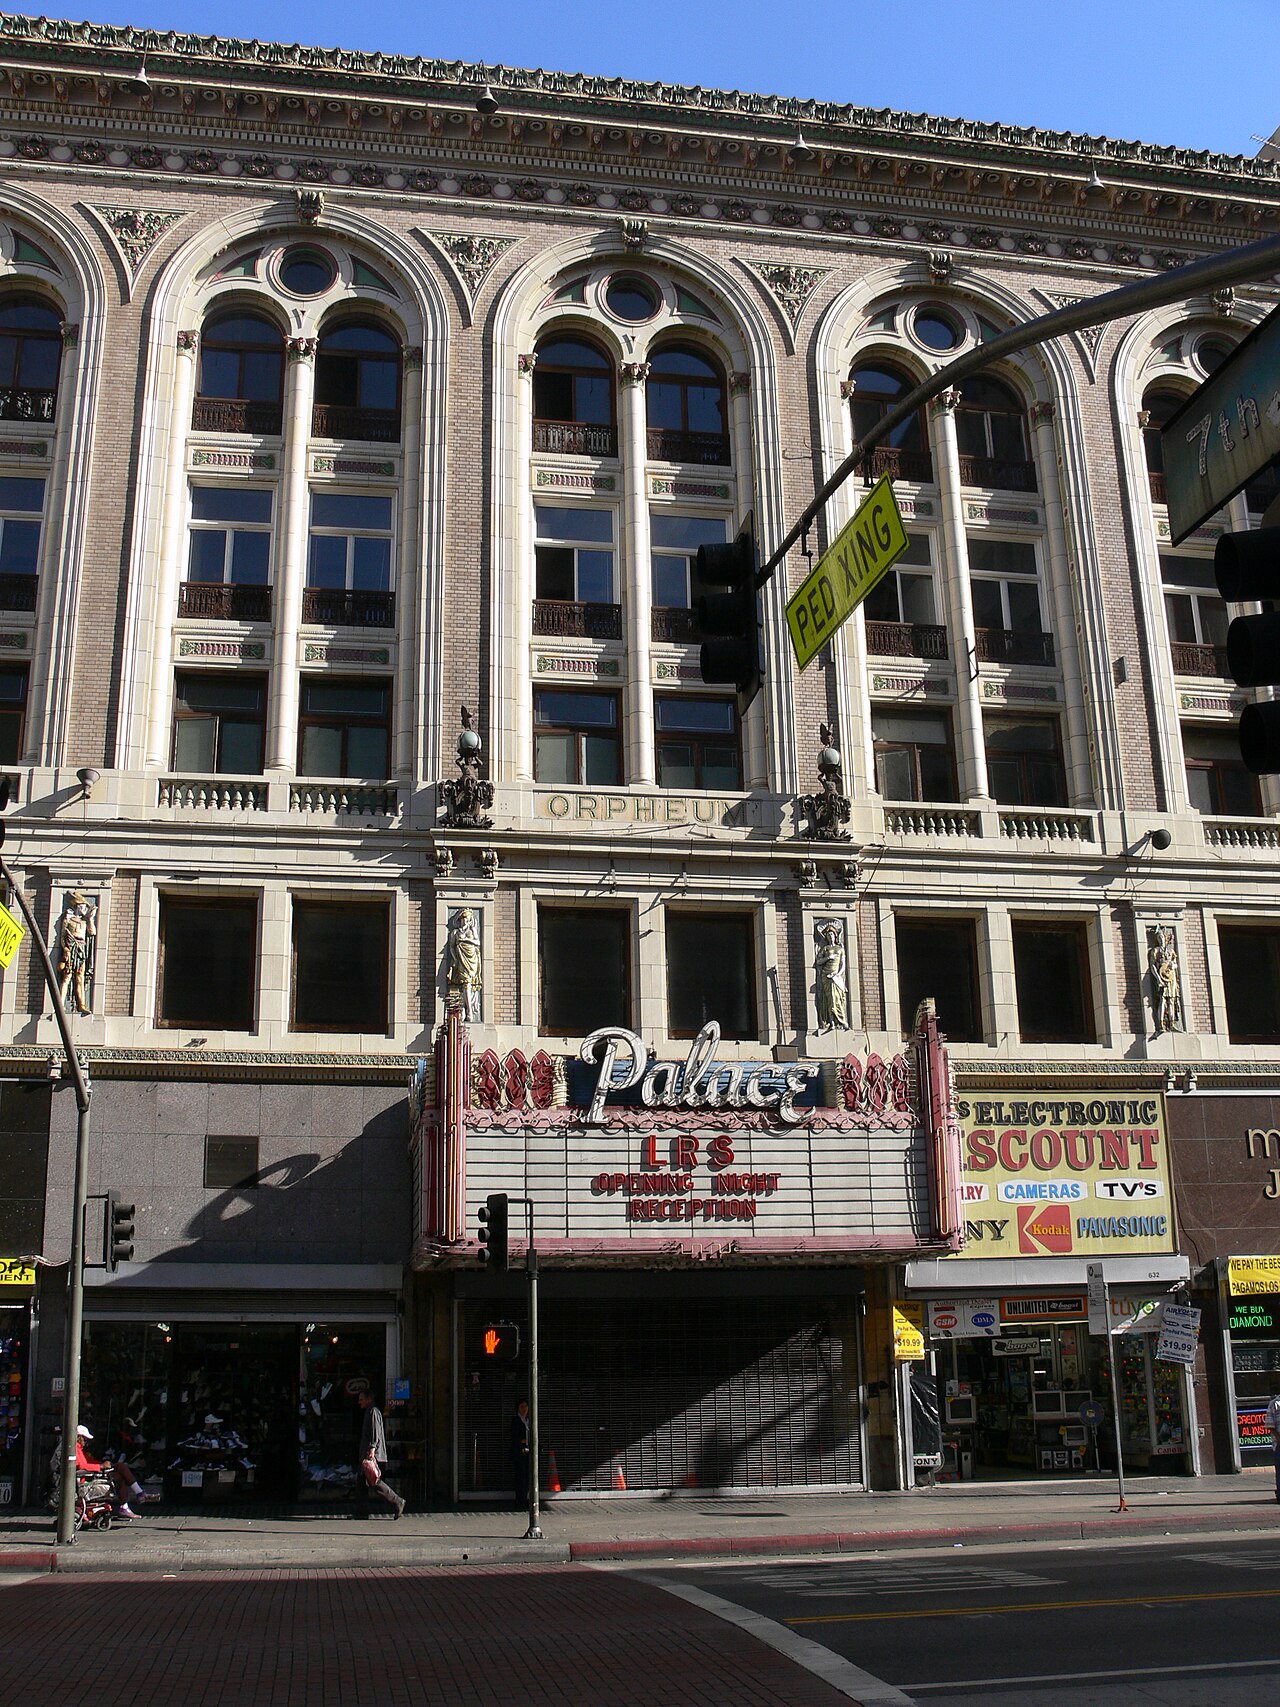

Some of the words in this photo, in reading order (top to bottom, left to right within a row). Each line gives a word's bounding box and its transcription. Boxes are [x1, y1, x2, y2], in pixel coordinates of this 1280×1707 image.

[1186, 395, 1260, 476] 7th
[794, 577, 835, 651] PED
[838, 503, 892, 597] XING
[547, 795, 748, 826] ORPHEUM
[580, 1019, 820, 1125] Palace
[974, 1100, 1159, 1126] ELECTRONIC
[598, 1172, 695, 1193] OPENING
[716, 1171, 782, 1193] NIGHT
[1003, 1183, 1081, 1199] CAMERAS
[1102, 1182, 1158, 1198] TV'S
[631, 1198, 758, 1219] RECEPTION
[1032, 1224, 1070, 1236] Kodak
[1077, 1215, 1168, 1239] PANASONIC
[1231, 1259, 1241, 1271] WE
[1241, 1258, 1254, 1270] PAY
[1255, 1258, 1268, 1270] THE
[1232, 1281, 1265, 1294] PAGAMOS
[1265, 1280, 1279, 1293] LOS
[1007, 1300, 1047, 1314] UNLIMITED
[1235, 1306, 1247, 1314] WE
[936, 1317, 955, 1327] GSM
[1229, 1315, 1273, 1328] DIAMOND
[897, 1338, 921, 1347] $19.99
[1163, 1340, 1192, 1352] $19.99
